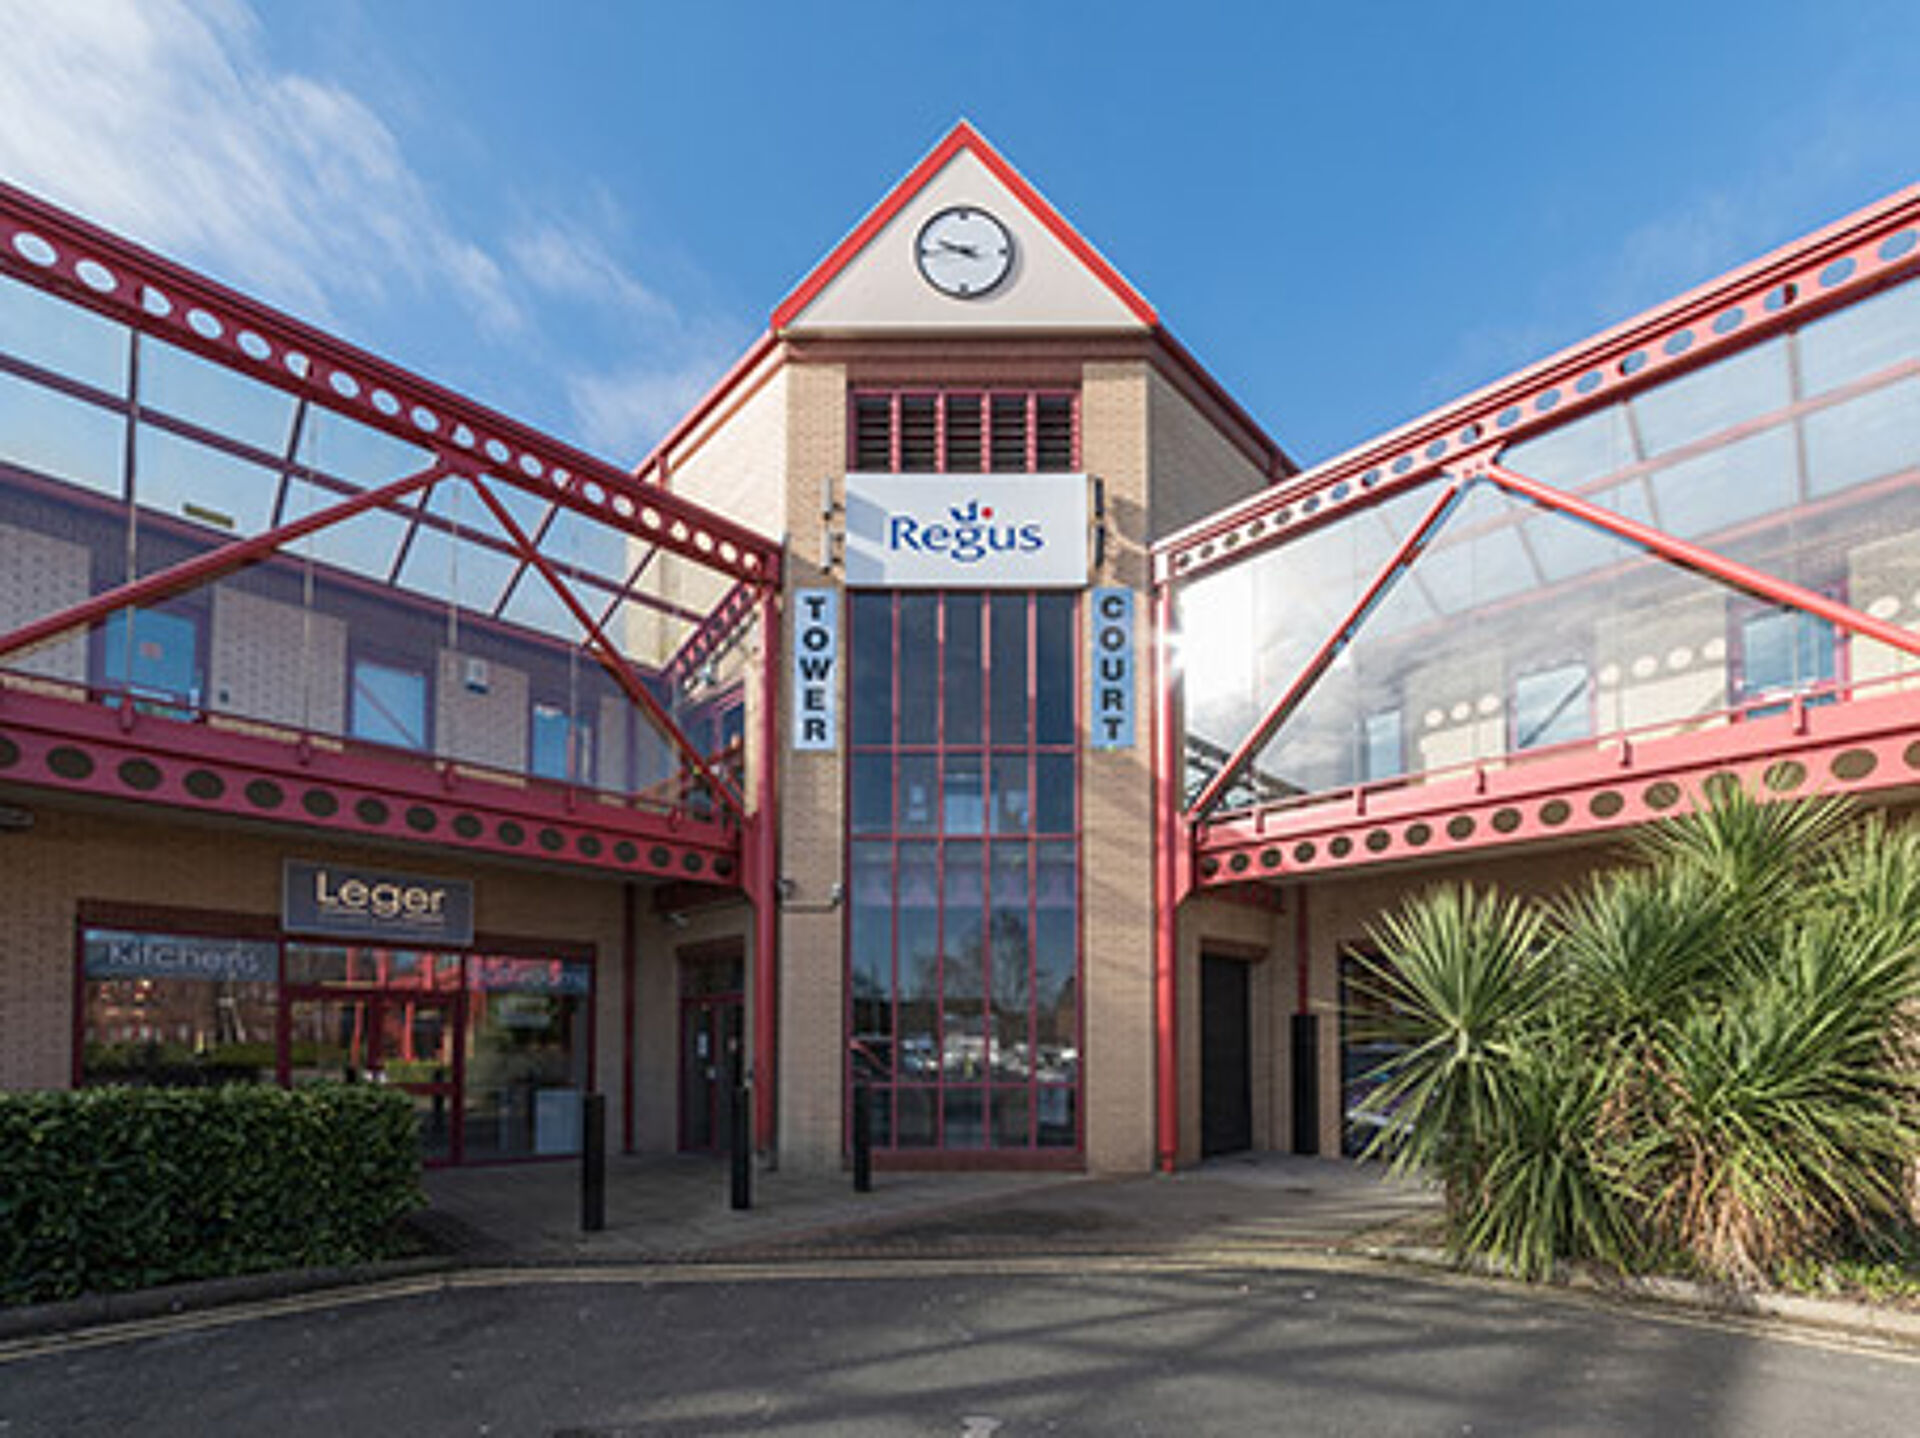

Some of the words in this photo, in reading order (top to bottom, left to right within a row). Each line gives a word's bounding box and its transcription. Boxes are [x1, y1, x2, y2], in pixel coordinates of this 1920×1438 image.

[891, 514, 1044, 563] Regus
[799, 596, 831, 741] TOWER
[1100, 595, 1125, 740] COURT
[315, 870, 445, 918] Leger
